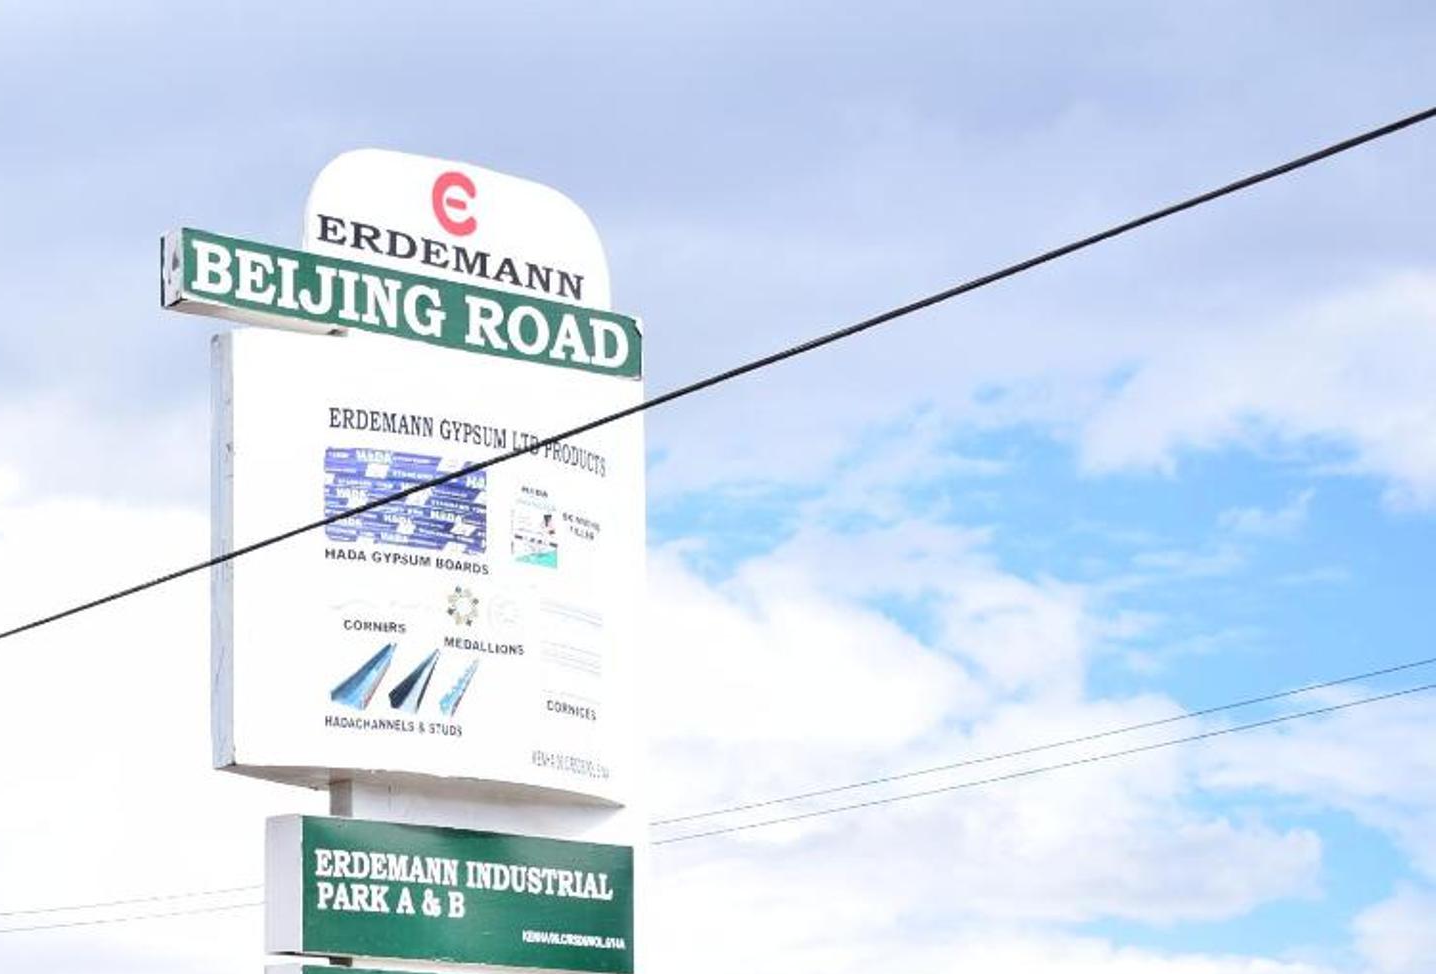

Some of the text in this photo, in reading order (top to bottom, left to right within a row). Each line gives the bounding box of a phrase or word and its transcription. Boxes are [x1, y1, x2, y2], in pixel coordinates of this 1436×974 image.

[316, 214, 585, 301] ERDEMANN
[190, 239, 630, 369] BEIJING ROAD
[328, 407, 434, 438] ERDEMANN
[440, 419, 507, 450] GYPSUM
[544, 441, 606, 478] PRODUCTS
[325, 548, 490, 576] HADA GYPSUM BOARDS
[443, 636, 525, 656] MEDALLIONS
[547, 699, 597, 721] CORNICES
[429, 722, 463, 737] STUDS
[314, 848, 613, 901] ERDEMANN INDUSTRIAL
[317, 882, 466, 919] PARK A & B
